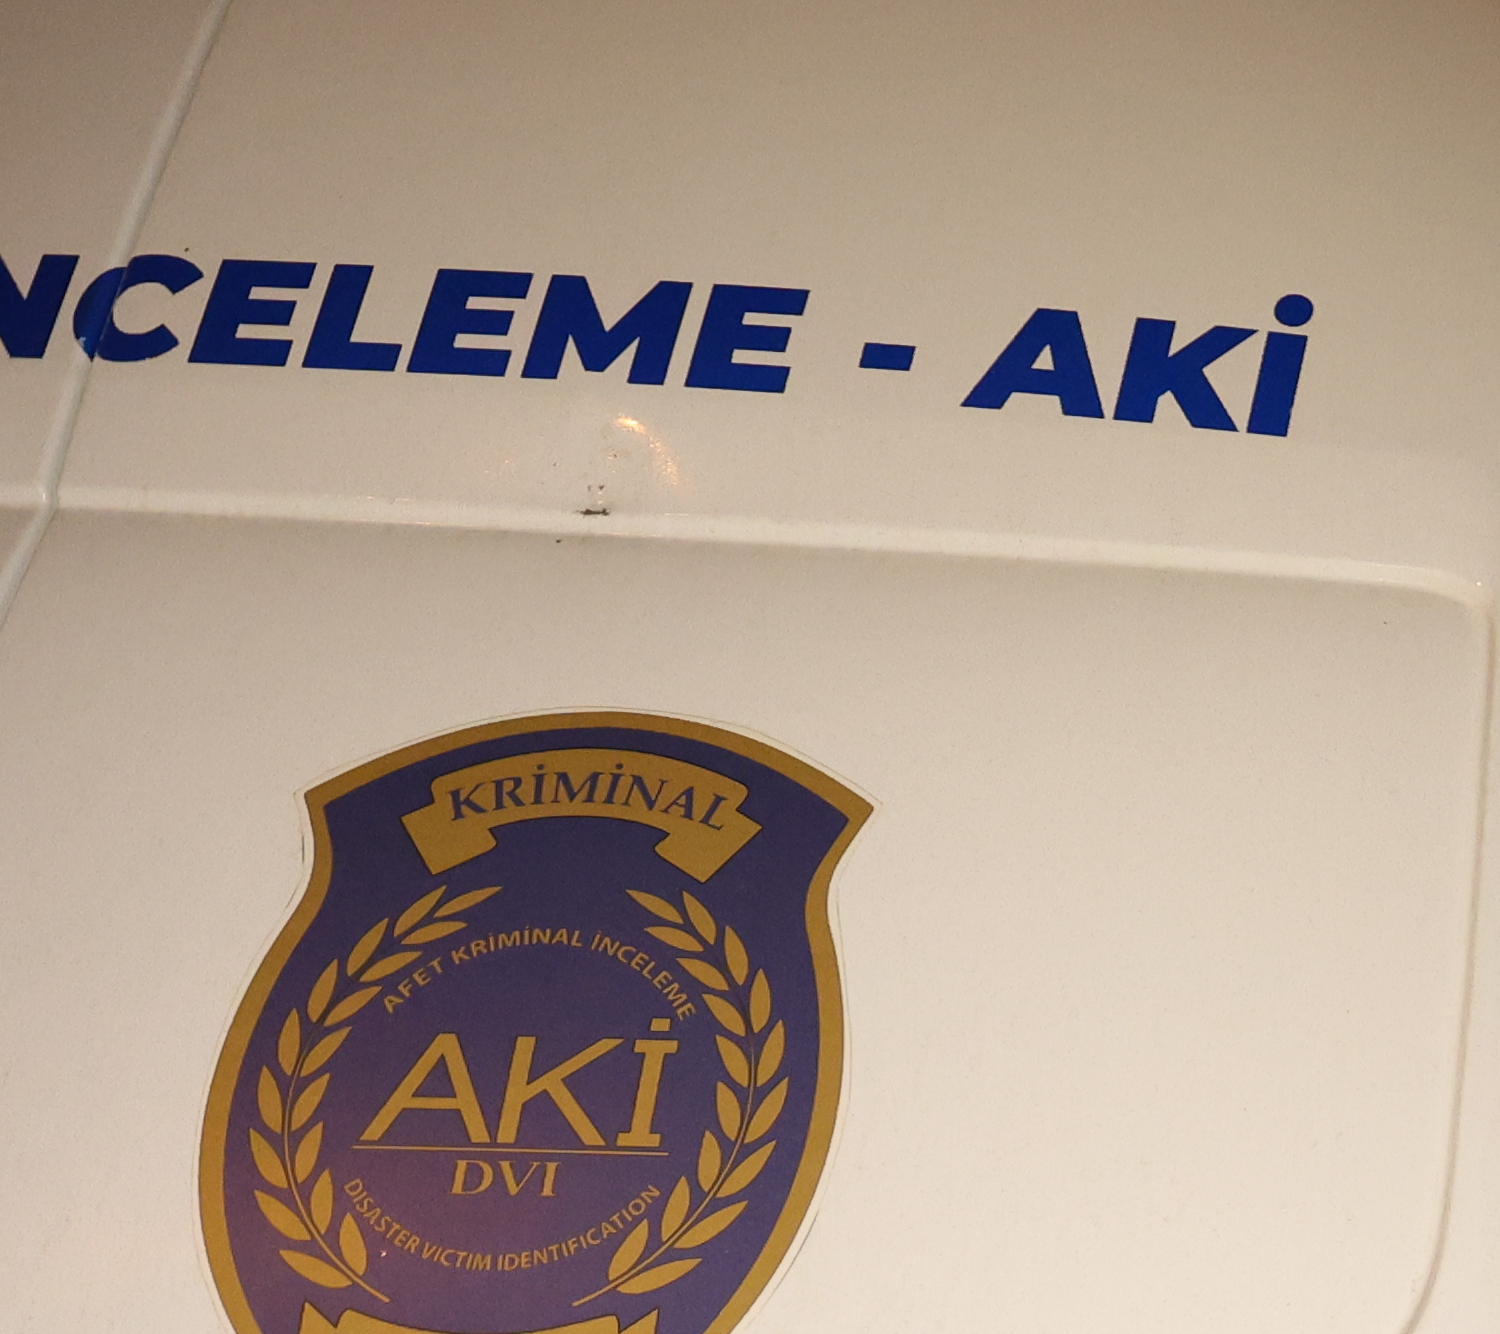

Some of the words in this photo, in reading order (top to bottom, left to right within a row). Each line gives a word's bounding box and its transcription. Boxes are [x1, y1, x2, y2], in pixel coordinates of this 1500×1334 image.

[860, 342, 916, 371] -
[961, 294, 1314, 437] AKİ
[448, 763, 728, 831] KRİMİNAL
[383, 957, 445, 1014] AFET
[451, 925, 584, 965] KRİMİNAL
[591, 929, 697, 1021] İNCELEME
[359, 1017, 679, 1148] AKİ
[343, 1178, 420, 1255] DISASTER
[421, 1242, 492, 1271] VICTIM
[497, 1184, 662, 1271] IDENTIFICATION
[450, 1159, 562, 1197] DVI
